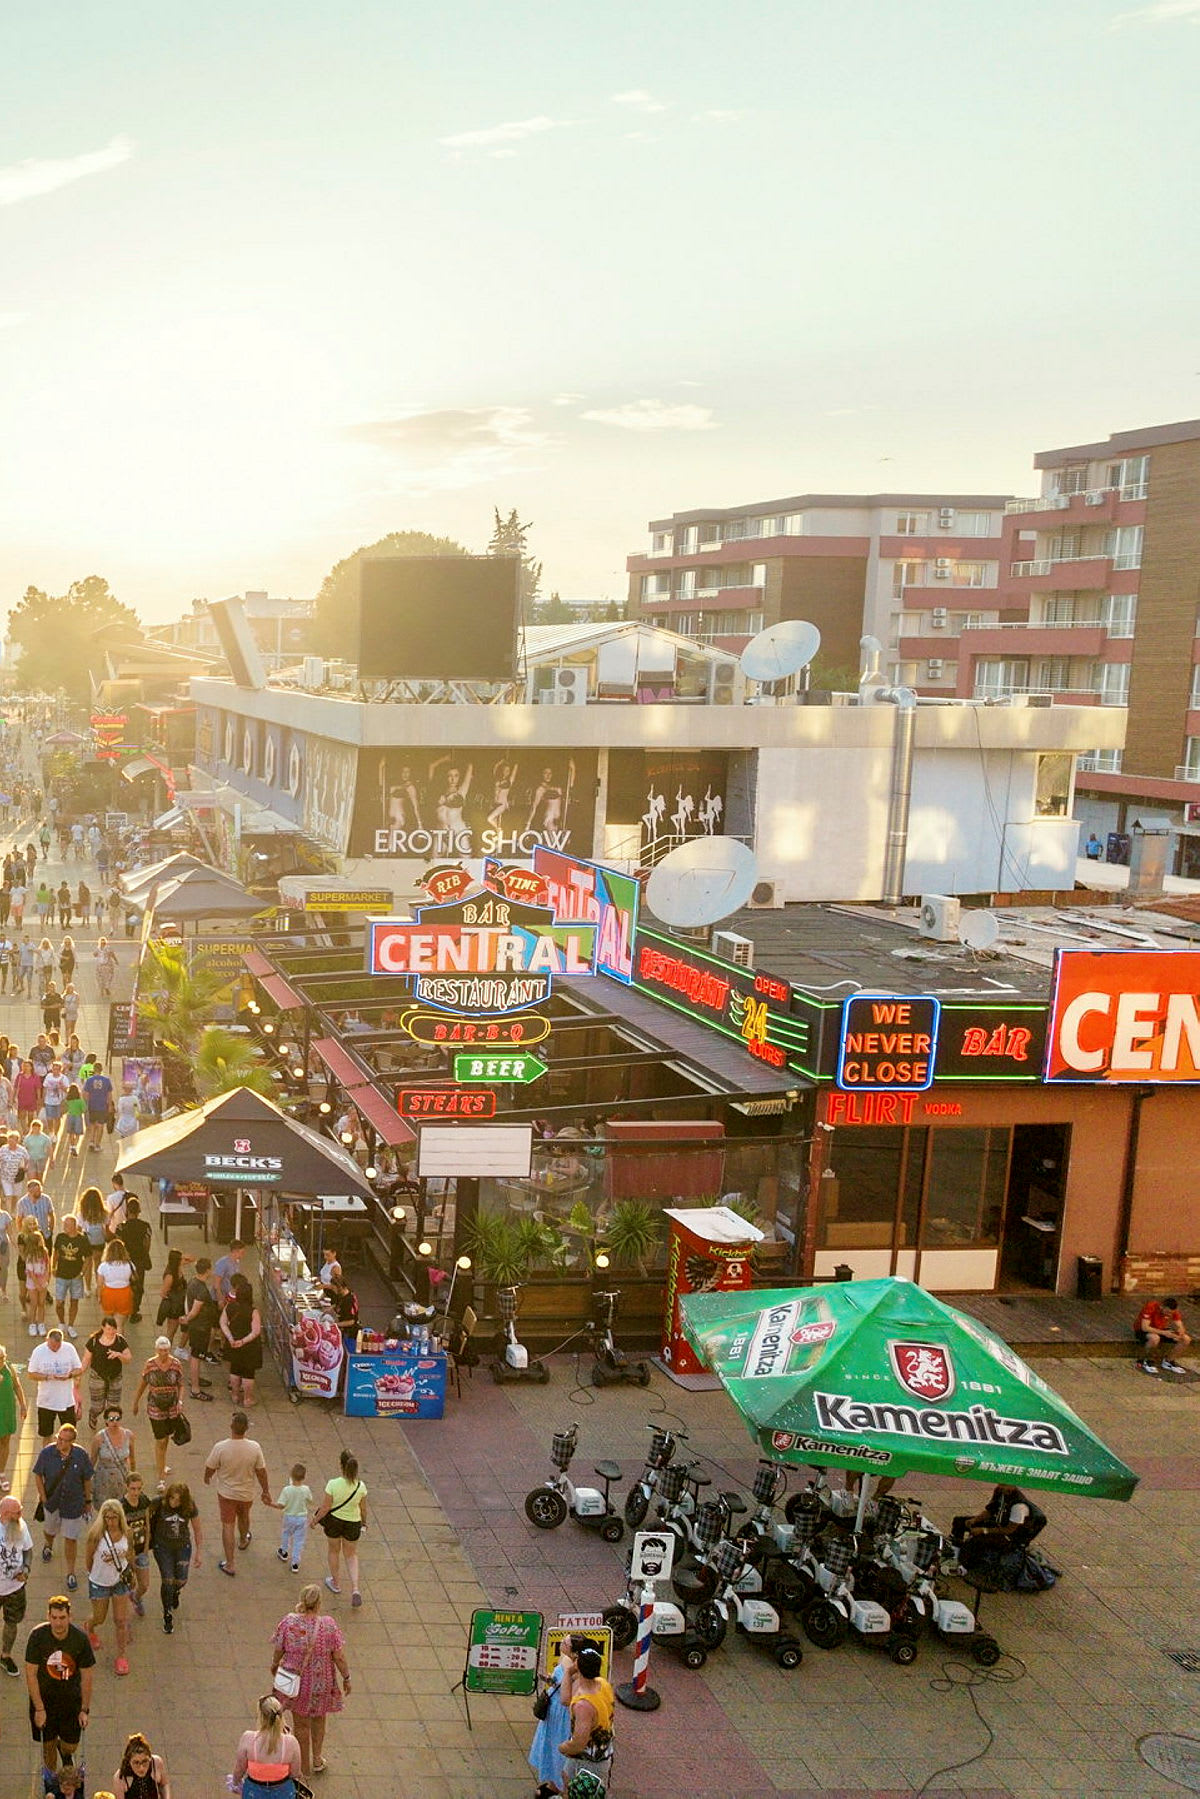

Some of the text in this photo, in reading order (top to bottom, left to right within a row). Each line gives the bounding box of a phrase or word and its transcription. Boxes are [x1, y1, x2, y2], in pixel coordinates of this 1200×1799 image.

[375, 829, 572, 854] EROTIC SHOW
[436, 875, 540, 893] RIB TIME
[310, 892, 388, 902] SUPERMARKET
[462, 899, 511, 926] BAR
[378, 927, 589, 972] CENTRAL
[640, 946, 730, 1010] RESTAURANT
[754, 976, 789, 1002] OPEN
[418, 977, 546, 1010] RESTAURANT
[742, 996, 768, 1044] 24
[871, 1003, 911, 1025] WE
[433, 1023, 524, 1042] BAR-B-Q
[846, 1033, 932, 1055] NEVER
[961, 1023, 1032, 1061] BAR
[1060, 992, 1200, 1073] CEN
[748, 1038, 787, 1067] HOURS
[470, 1060, 526, 1079] BEER
[844, 1061, 929, 1083] CLOSE
[409, 1094, 486, 1114] STEAKS
[828, 1091, 963, 1125] FLIRT VODKA
[205, 1156, 282, 1169] BECK'S
[754, 1303, 793, 1376] Kamenitza
[960, 1380, 1003, 1394] 1881
[815, 1392, 1067, 1454] Kamenitza
[794, 1436, 891, 1461] Kamenitza
[979, 1461, 1025, 1476] МЪЖЕТЕ
[1026, 1467, 1061, 1480] ЗНАЯТ
[559, 1617, 602, 1627] TATTOO
